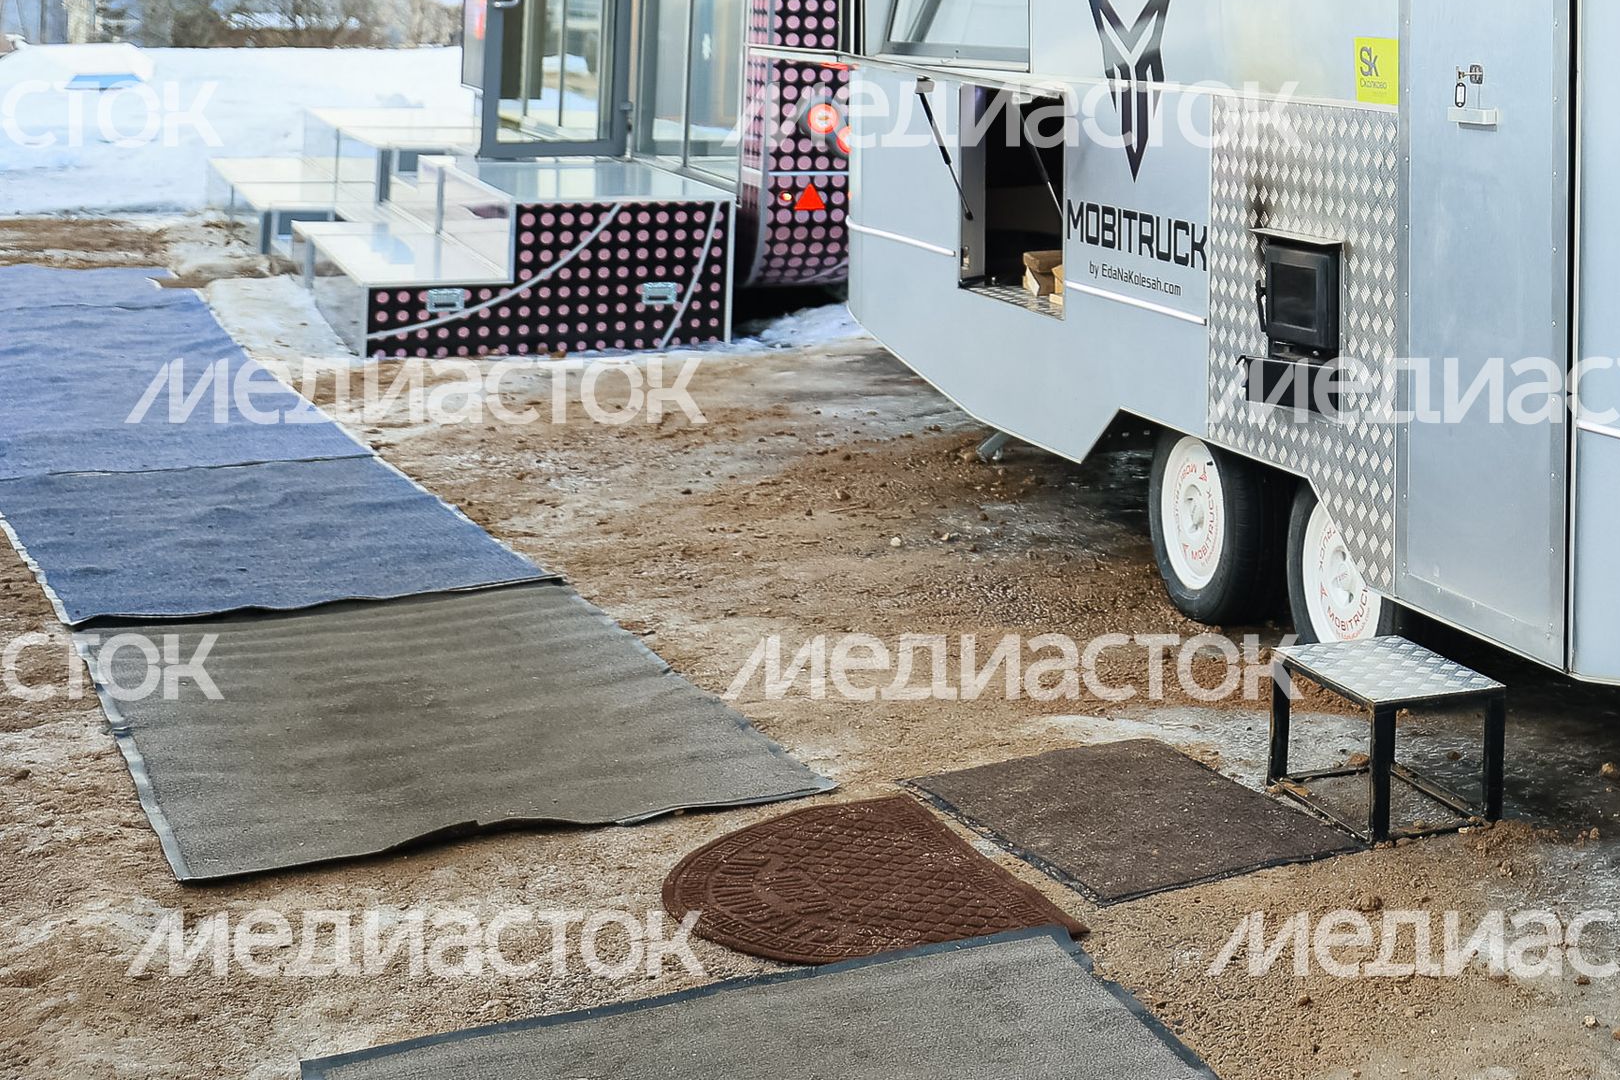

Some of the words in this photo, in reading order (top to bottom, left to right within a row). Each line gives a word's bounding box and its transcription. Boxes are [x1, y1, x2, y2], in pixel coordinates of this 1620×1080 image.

[1067, 198, 1208, 272] MOBITRUCK
[1089, 261, 1099, 279] by
[1101, 263, 1182, 297] EdaNaKolesah.com
